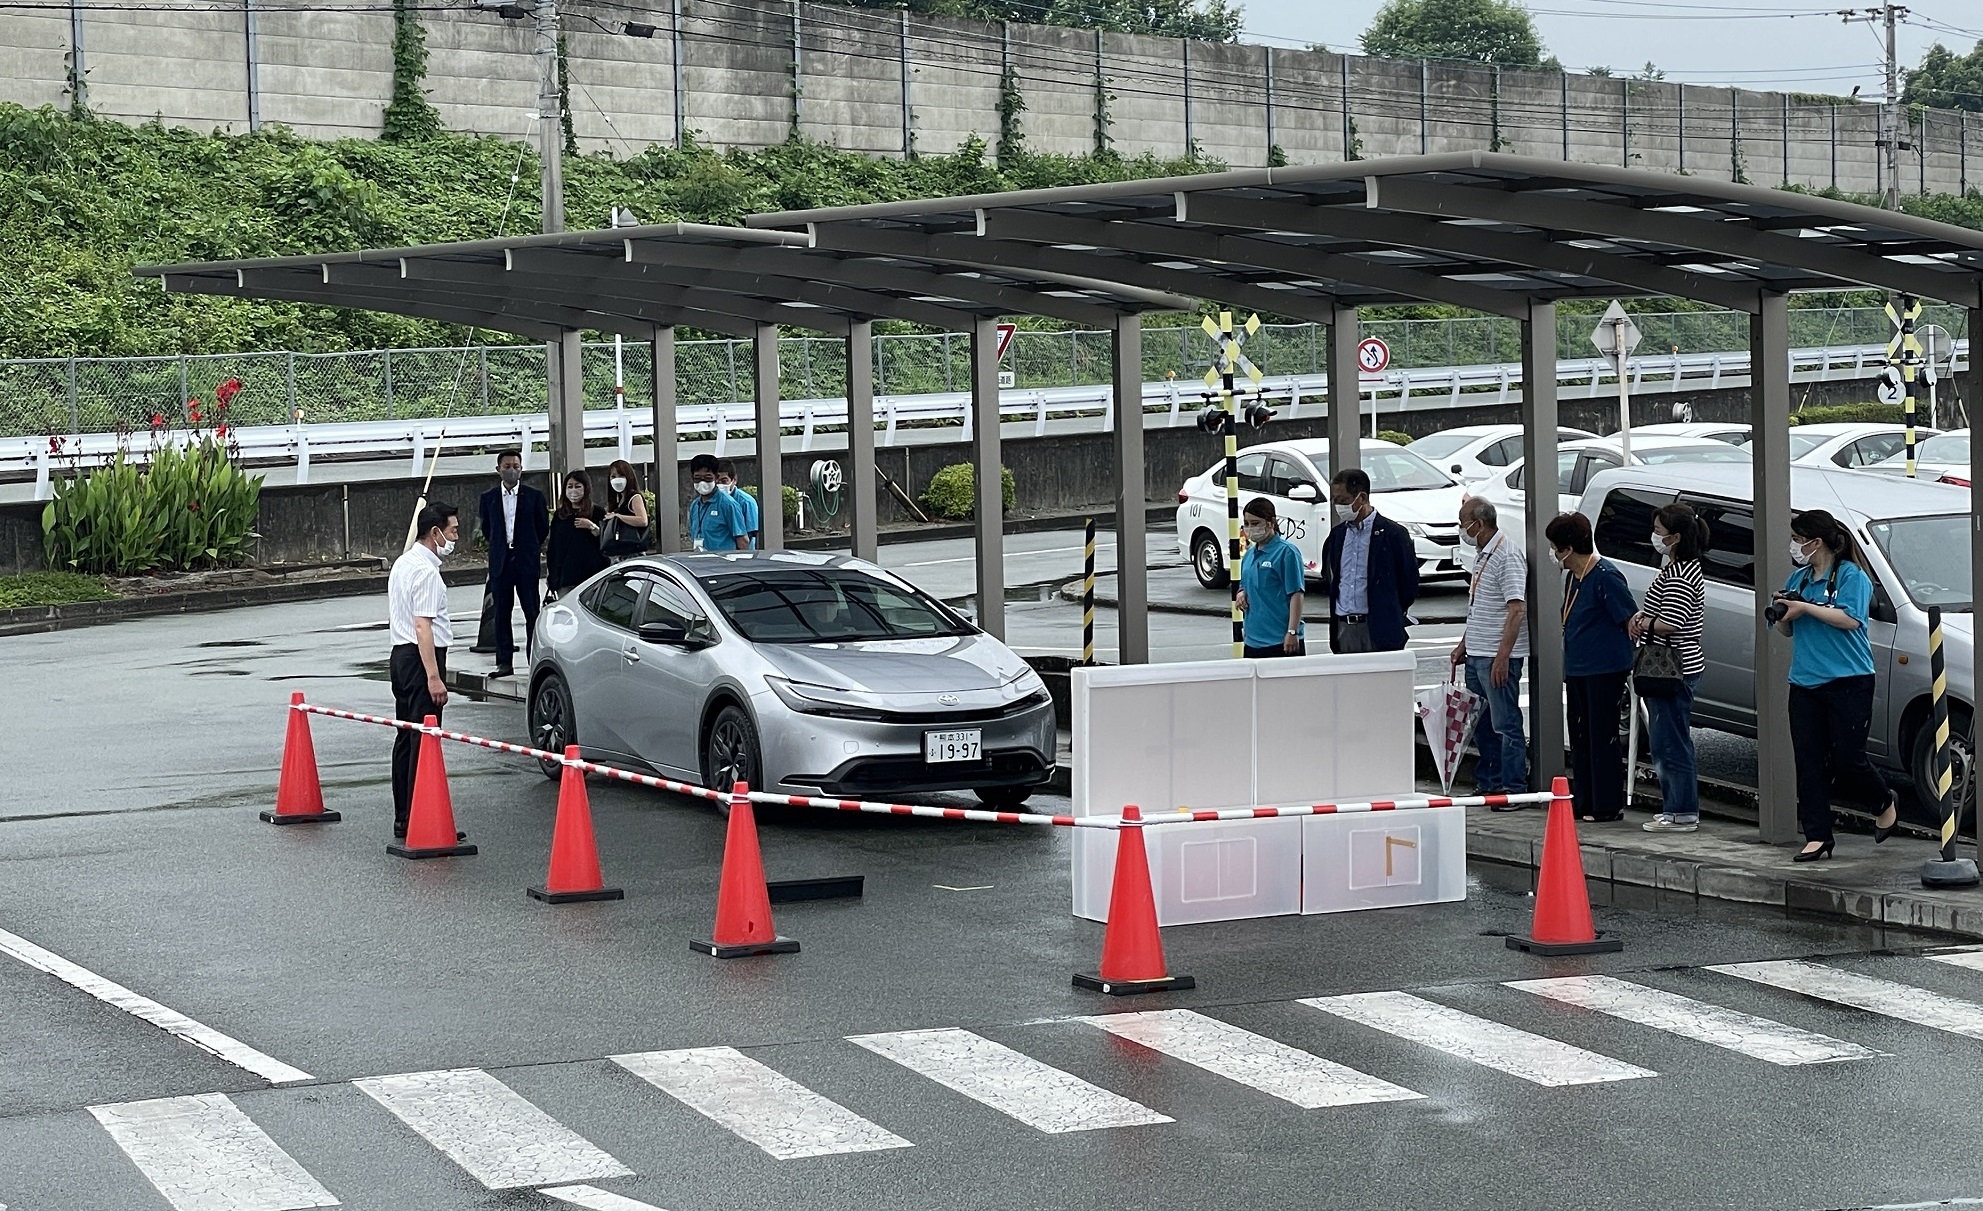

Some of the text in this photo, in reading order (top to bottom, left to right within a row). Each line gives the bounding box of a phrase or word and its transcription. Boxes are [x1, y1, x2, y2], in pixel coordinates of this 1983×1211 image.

[1887, 386, 1897, 399] 2
[1189, 503, 1203, 518] 101
[940, 742, 979, 760] 19-97
